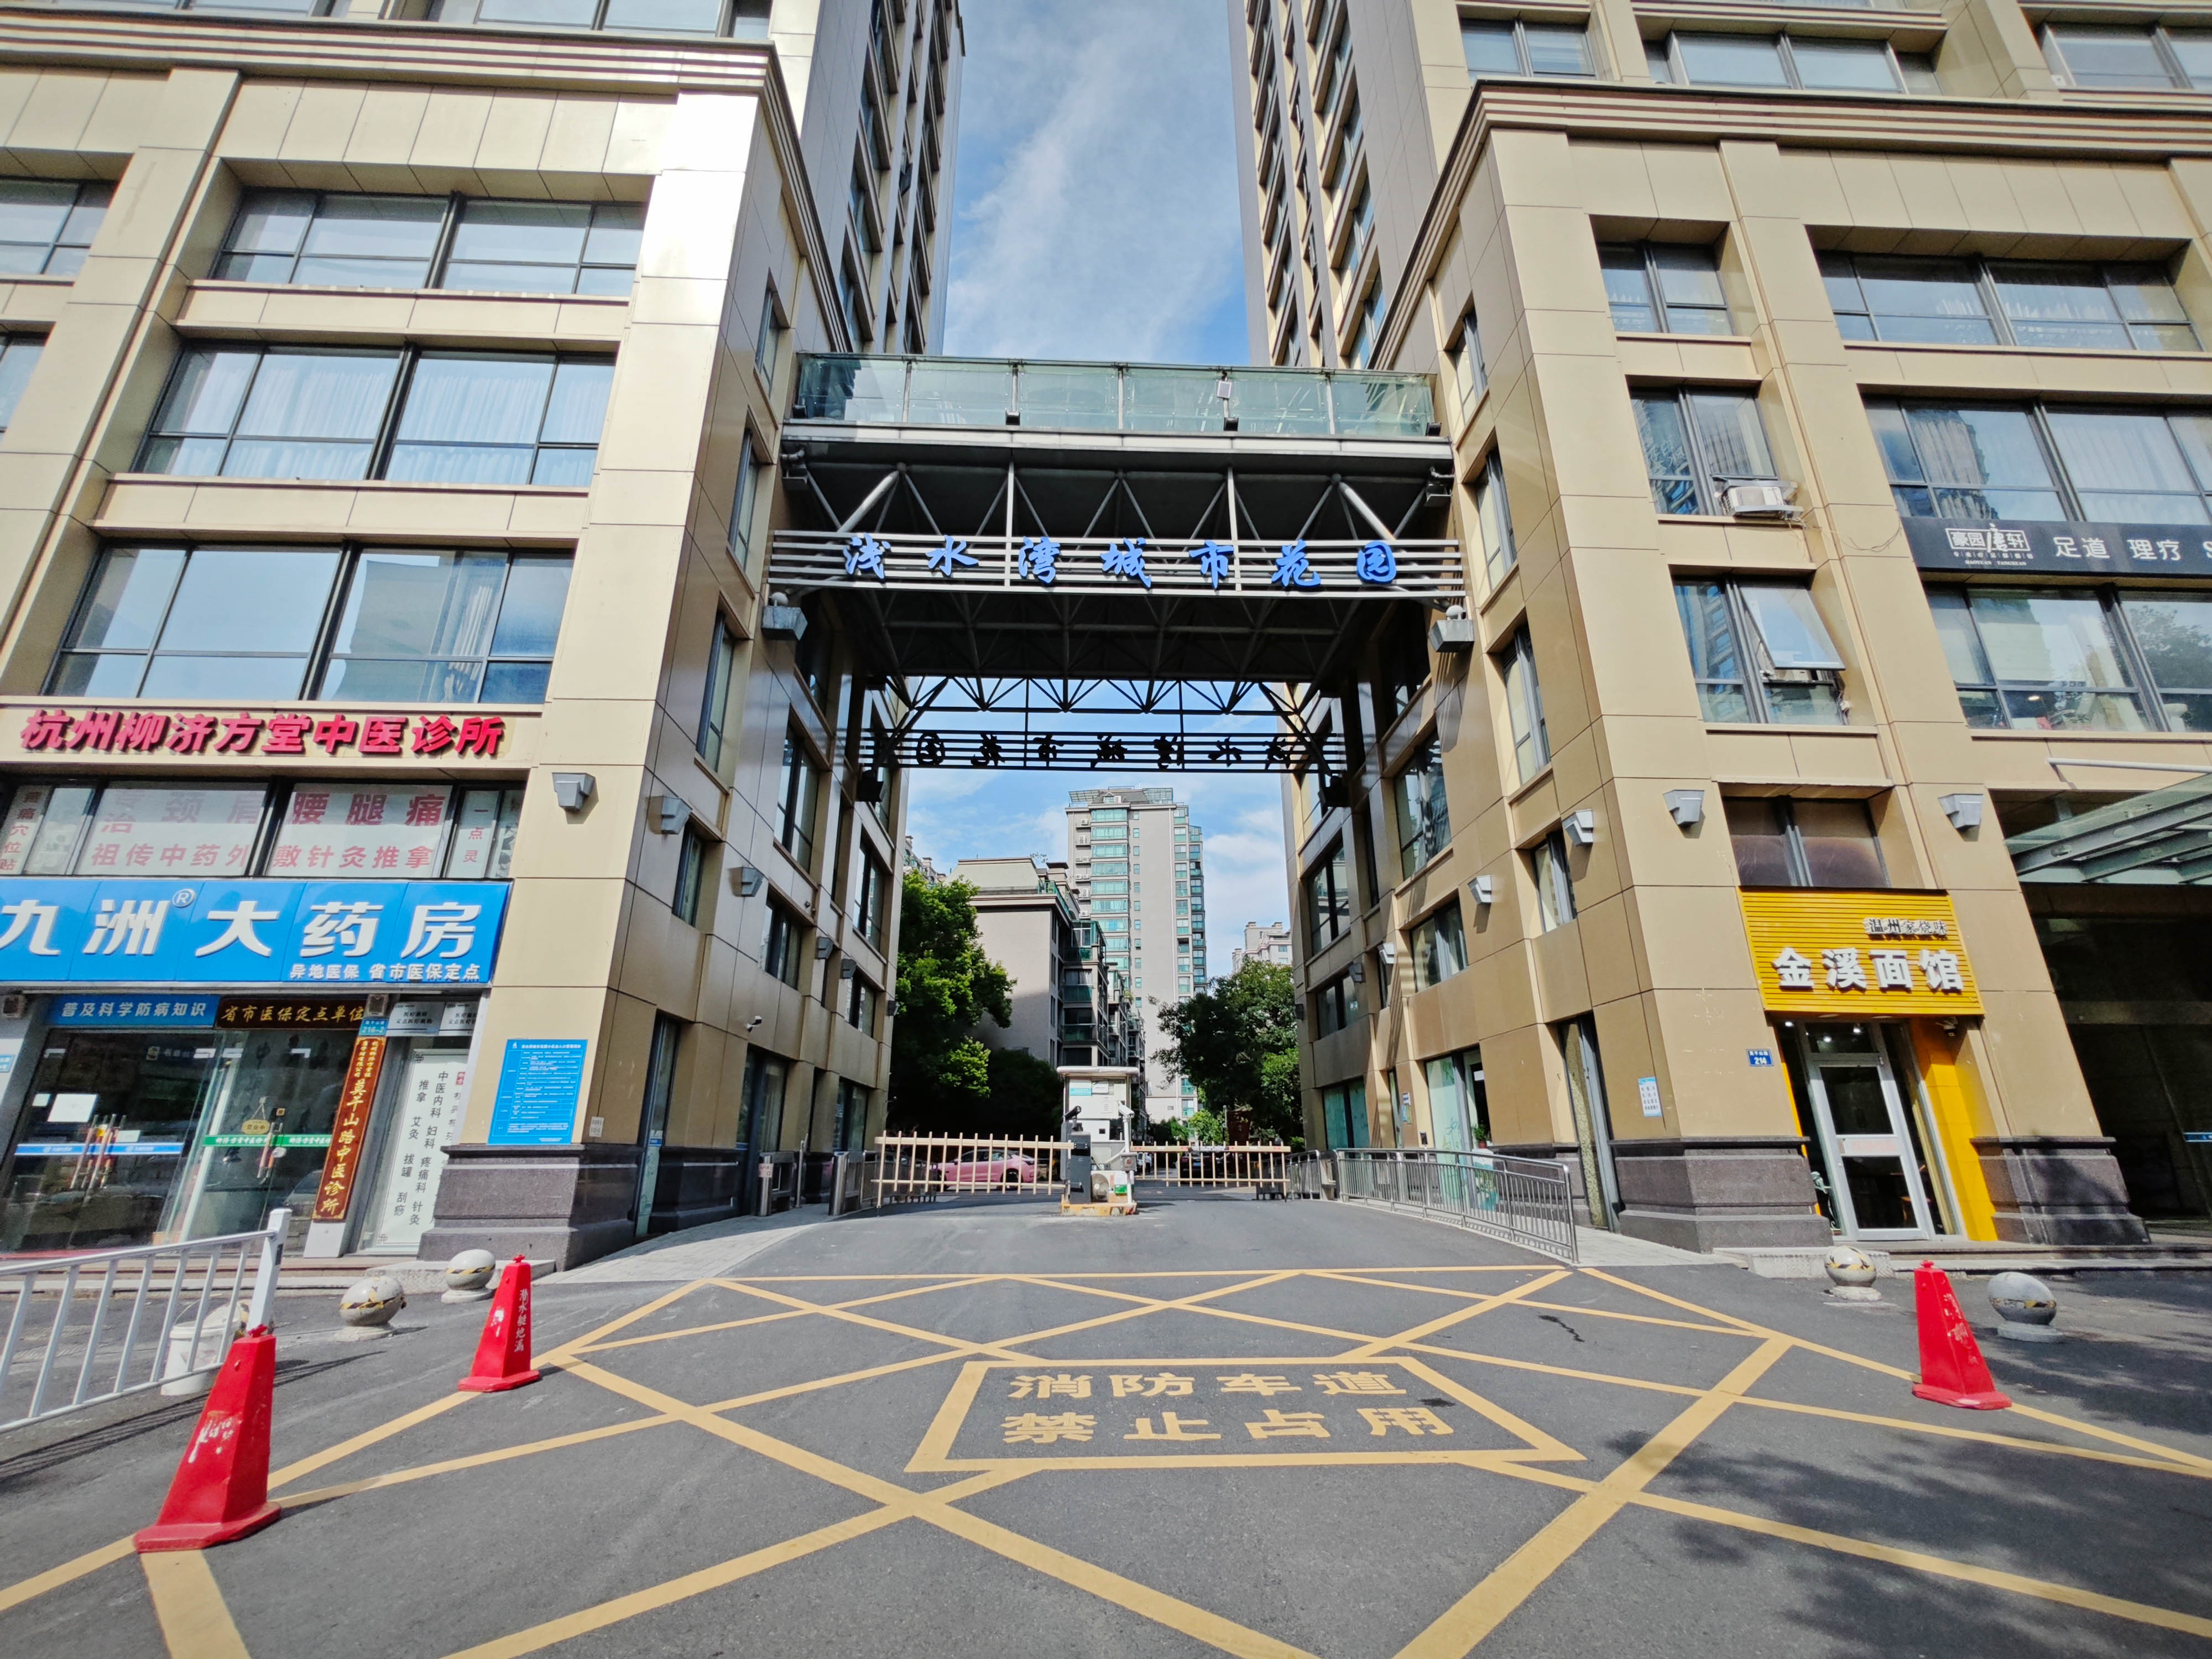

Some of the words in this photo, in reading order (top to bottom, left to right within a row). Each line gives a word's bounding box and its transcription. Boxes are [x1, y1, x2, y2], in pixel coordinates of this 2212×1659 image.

[2053, 536, 2110, 559] 足道
[2127, 539, 2181, 560] 理疗
[844, 534, 1397, 588] 浅水湾城市花园
[20, 709, 504, 755] 杭州柳济方堂中医诊所
[463, 809, 489, 863] 一点灵
[289, 963, 360, 980] 异地医保
[369, 963, 481, 981] 省市医保定点
[1772, 947, 1964, 990] 金溪面馆
[61, 1002, 207, 1018] 普及科学防病知识
[222, 1005, 364, 1022] 省市医保定点单位
[415, 1079, 429, 1103] 推拿
[430, 1071, 448, 1119] 中医内科
[408, 1116, 422, 1140] 艾灸
[424, 1126, 437, 1149] 妇科
[320, 1078, 367, 1215] 莫干山路中医诊所
[401, 1153, 415, 1178] 拔罐
[415, 1157, 432, 1193] 疼痛科
[393, 1192, 408, 1216] 刮痧
[409, 1201, 424, 1225] 针灸
[1009, 1371, 1407, 1399] 消防车道
[1003, 1408, 1455, 1443] 禁止占用
